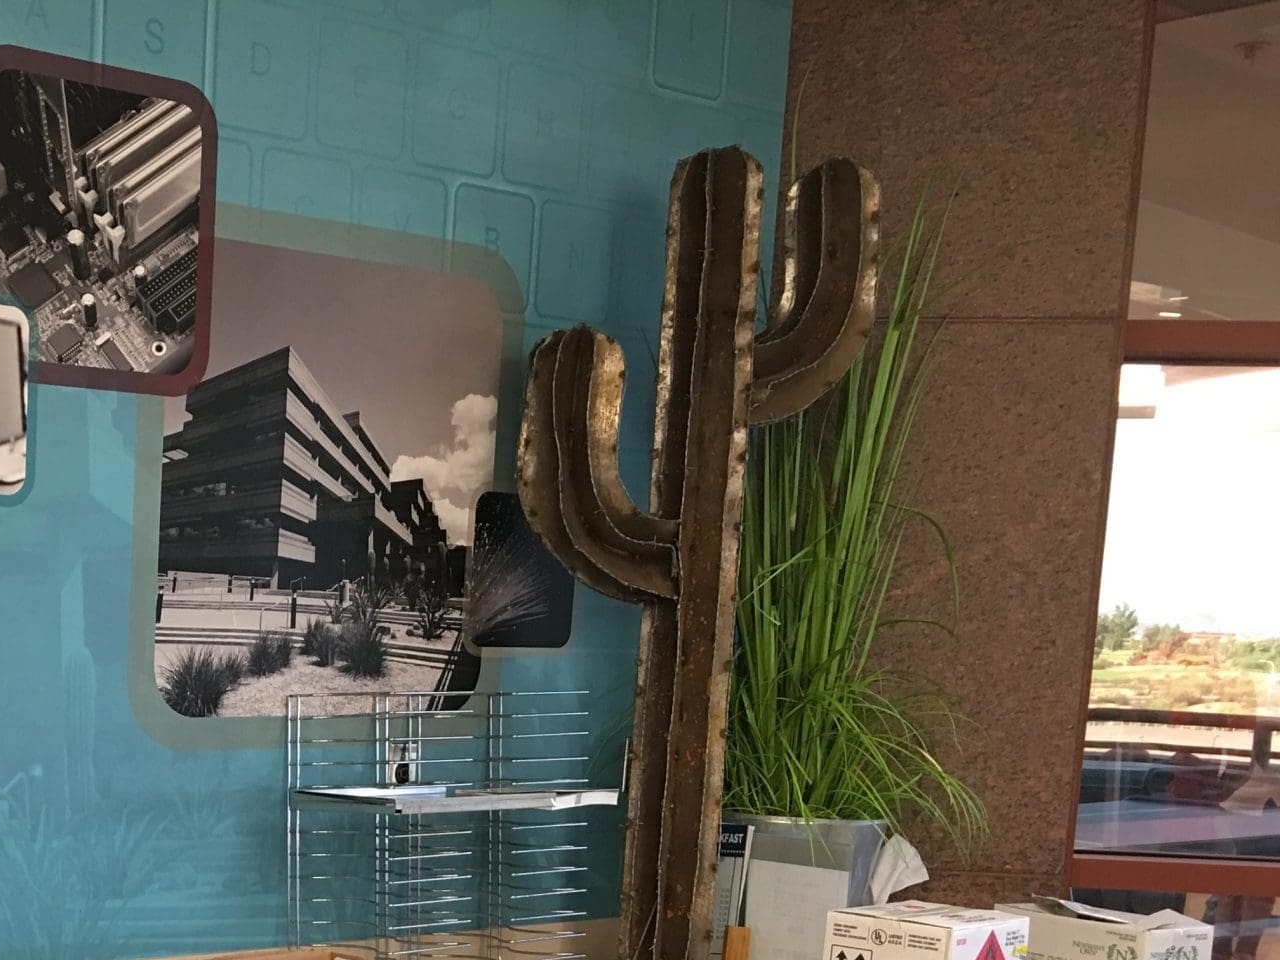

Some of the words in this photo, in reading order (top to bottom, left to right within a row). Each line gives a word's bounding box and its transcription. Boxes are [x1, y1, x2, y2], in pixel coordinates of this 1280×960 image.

[143, 16, 166, 55] S
[250, 41, 272, 77] D
[484, 226, 501, 257] B
